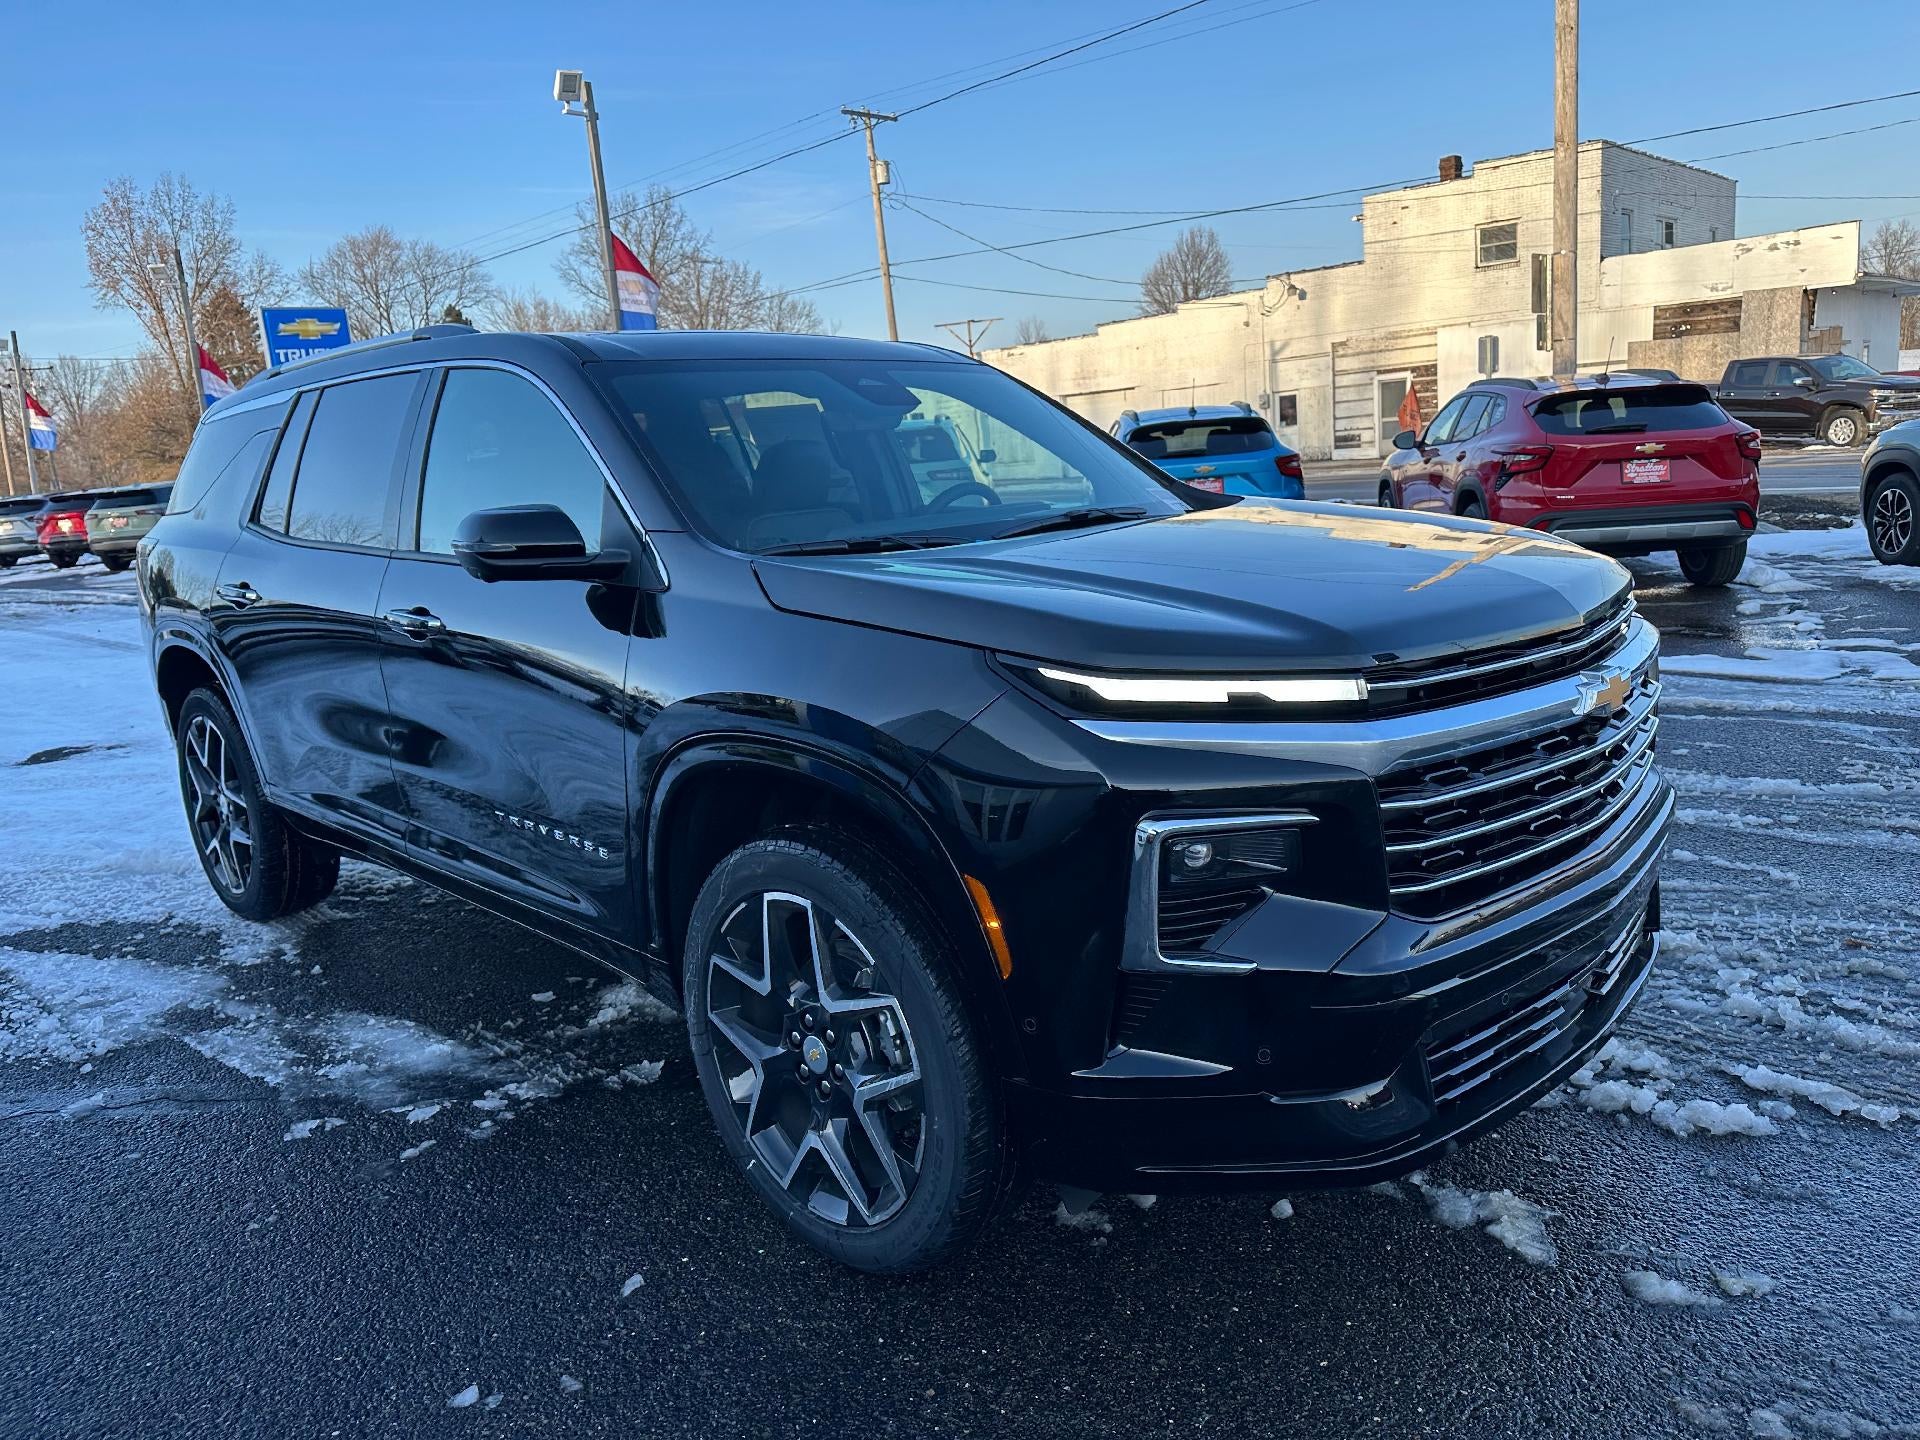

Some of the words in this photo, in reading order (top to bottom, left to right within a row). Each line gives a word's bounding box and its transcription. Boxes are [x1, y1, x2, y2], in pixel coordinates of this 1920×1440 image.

[275, 348, 330, 362] TRU
[1624, 462, 1667, 473] Stratton
[494, 810, 609, 860] TRAVERSE
